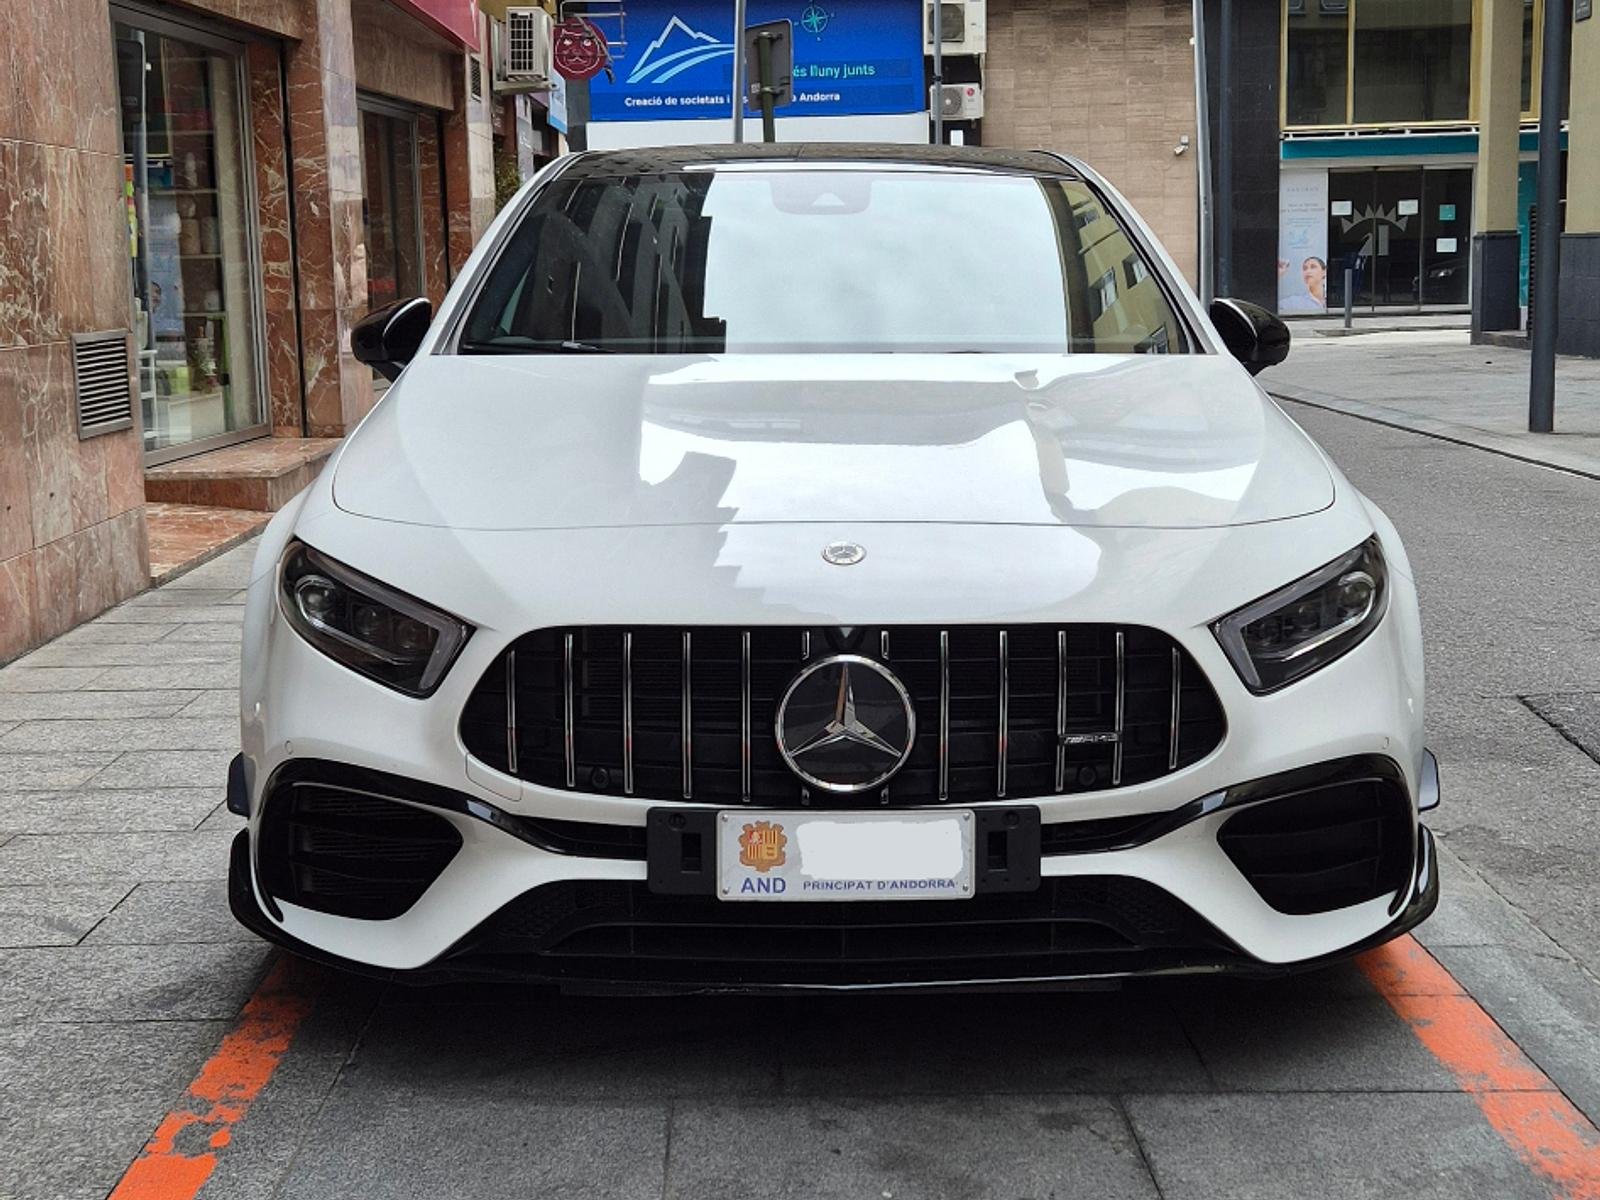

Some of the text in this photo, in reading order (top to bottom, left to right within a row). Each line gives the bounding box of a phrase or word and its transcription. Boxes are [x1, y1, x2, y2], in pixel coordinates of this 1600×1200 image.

[792, 64, 876, 78] és lluny junts
[624, 95, 663, 107] Creació
[664, 95, 678, 106] de
[679, 95, 725, 106] societats
[799, 92, 841, 102] Andorra
[741, 877, 787, 894] AND
[803, 879, 956, 891] PRINCIPAT D'ANDORRA
